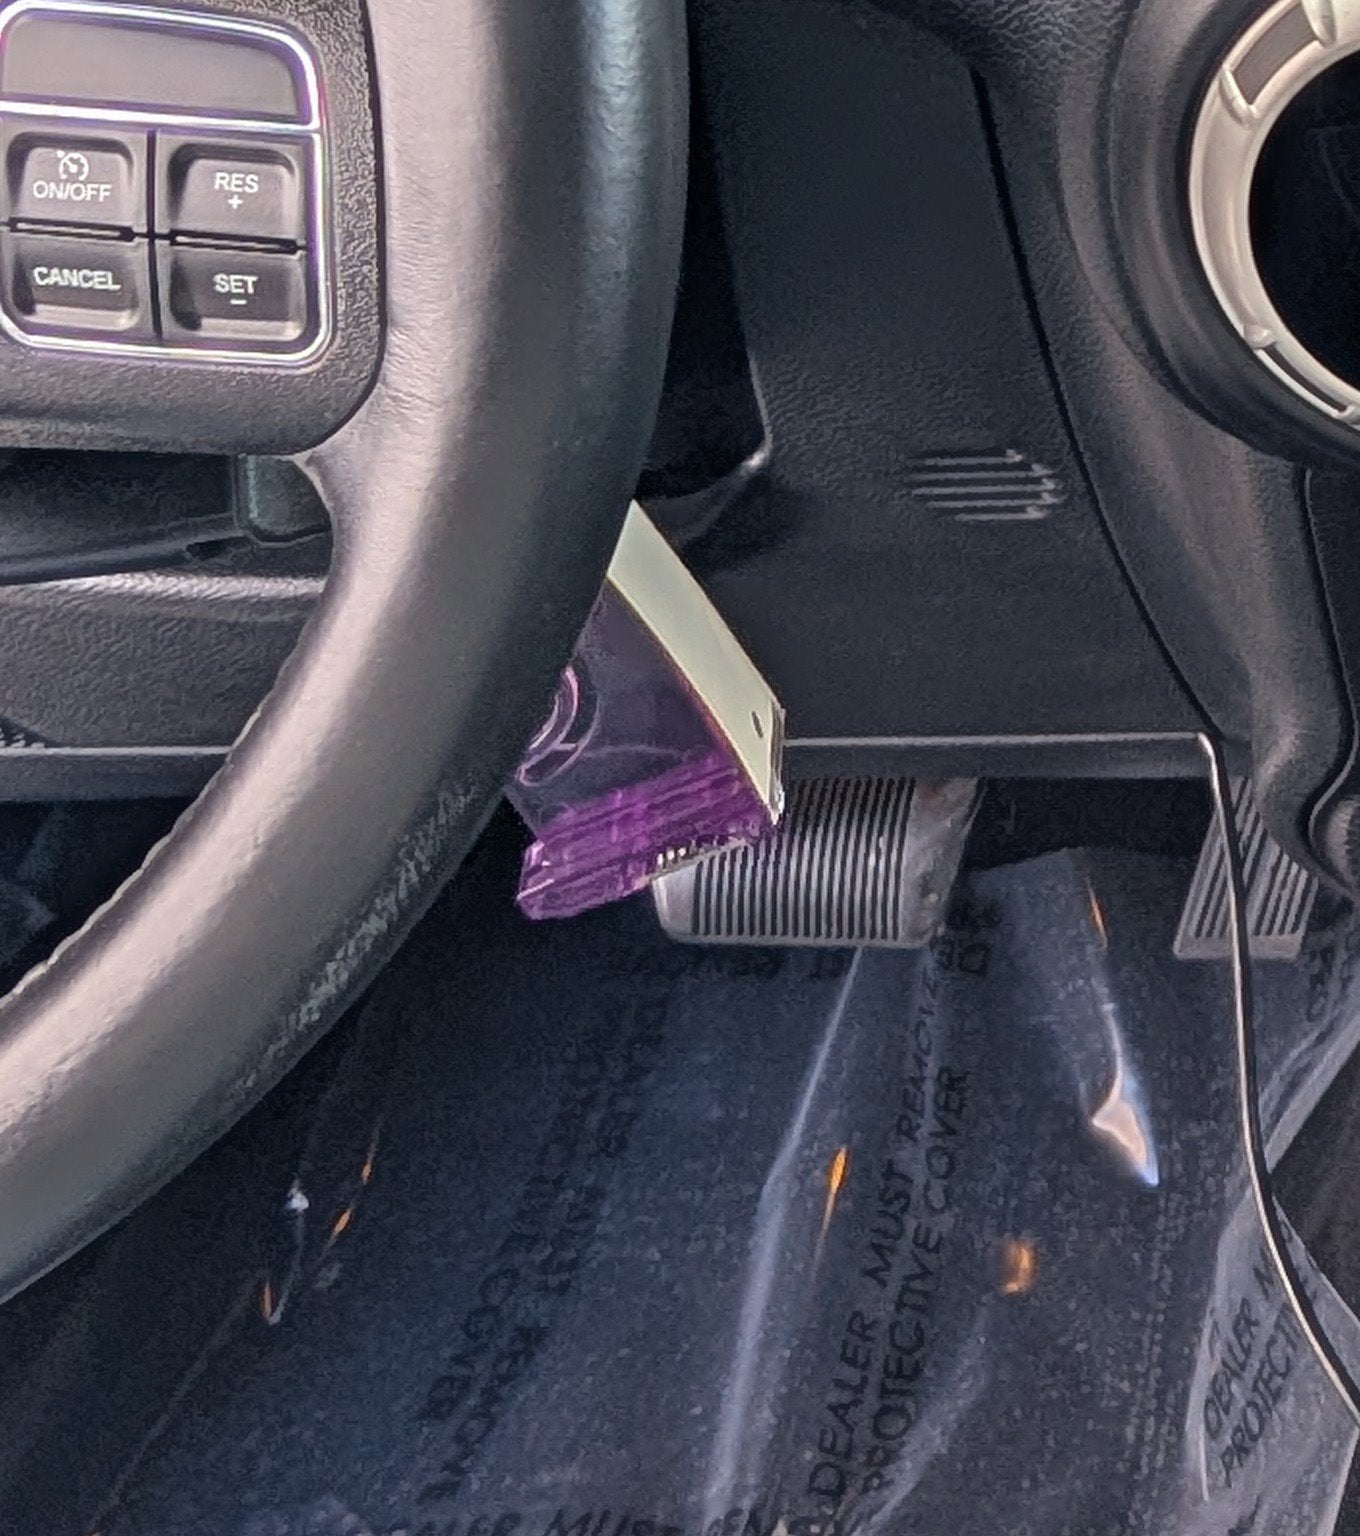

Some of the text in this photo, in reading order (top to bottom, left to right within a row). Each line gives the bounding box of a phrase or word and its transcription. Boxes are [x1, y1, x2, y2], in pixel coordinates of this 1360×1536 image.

[32, 180, 112, 202] ON/OFF
[214, 172, 259, 193] RES
[32, 267, 122, 291] CANCEL
[213, 274, 259, 295] SET
[920, 1068, 968, 1212] COVER
[808, 1310, 876, 1500] DEALER
[862, 1160, 913, 1288] MUST
[1202, 1297, 1258, 1441] DEALER
[1221, 1300, 1300, 1490] PROTECTI
